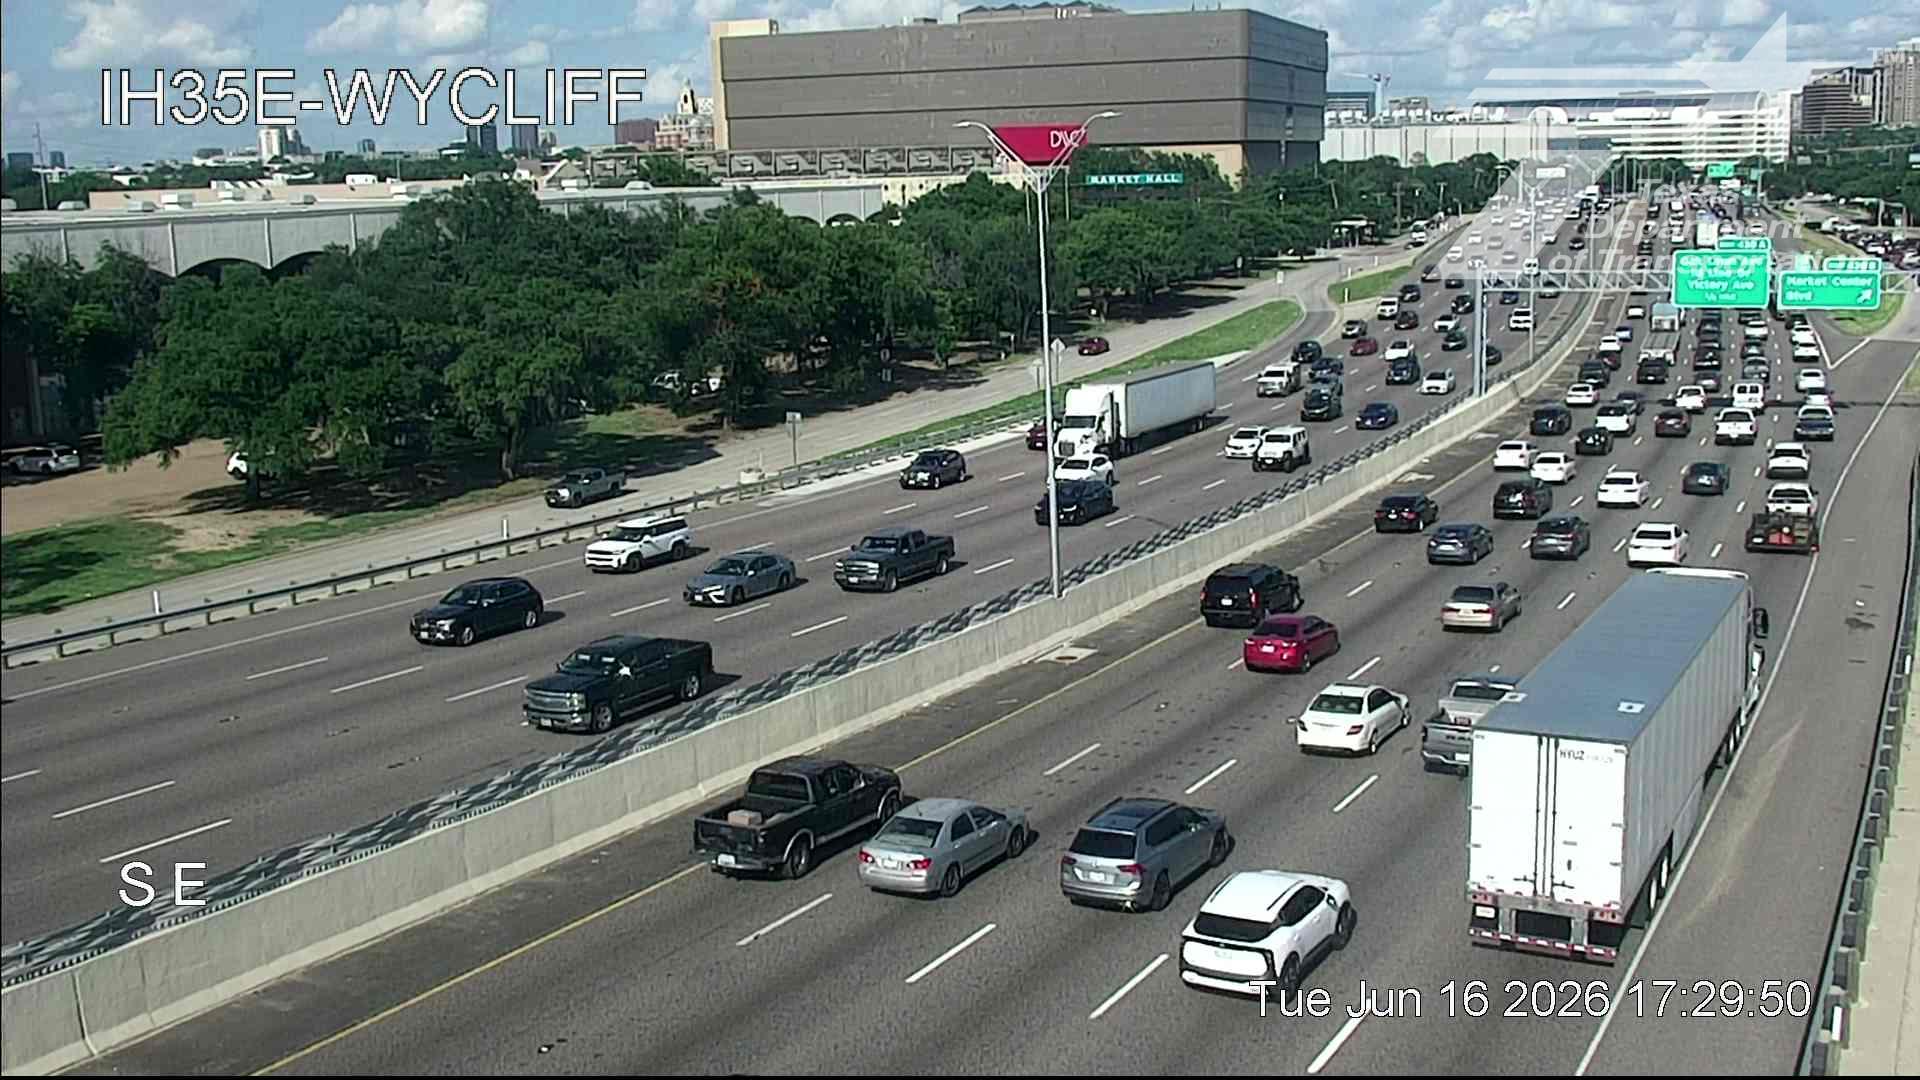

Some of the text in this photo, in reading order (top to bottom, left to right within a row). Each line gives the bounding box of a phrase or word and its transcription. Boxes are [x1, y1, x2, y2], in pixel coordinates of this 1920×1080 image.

[1090, 173, 1178, 184] MARKET HALL
[1687, 280, 1728, 292] Victory
[1785, 276, 1873, 287] Market Center
